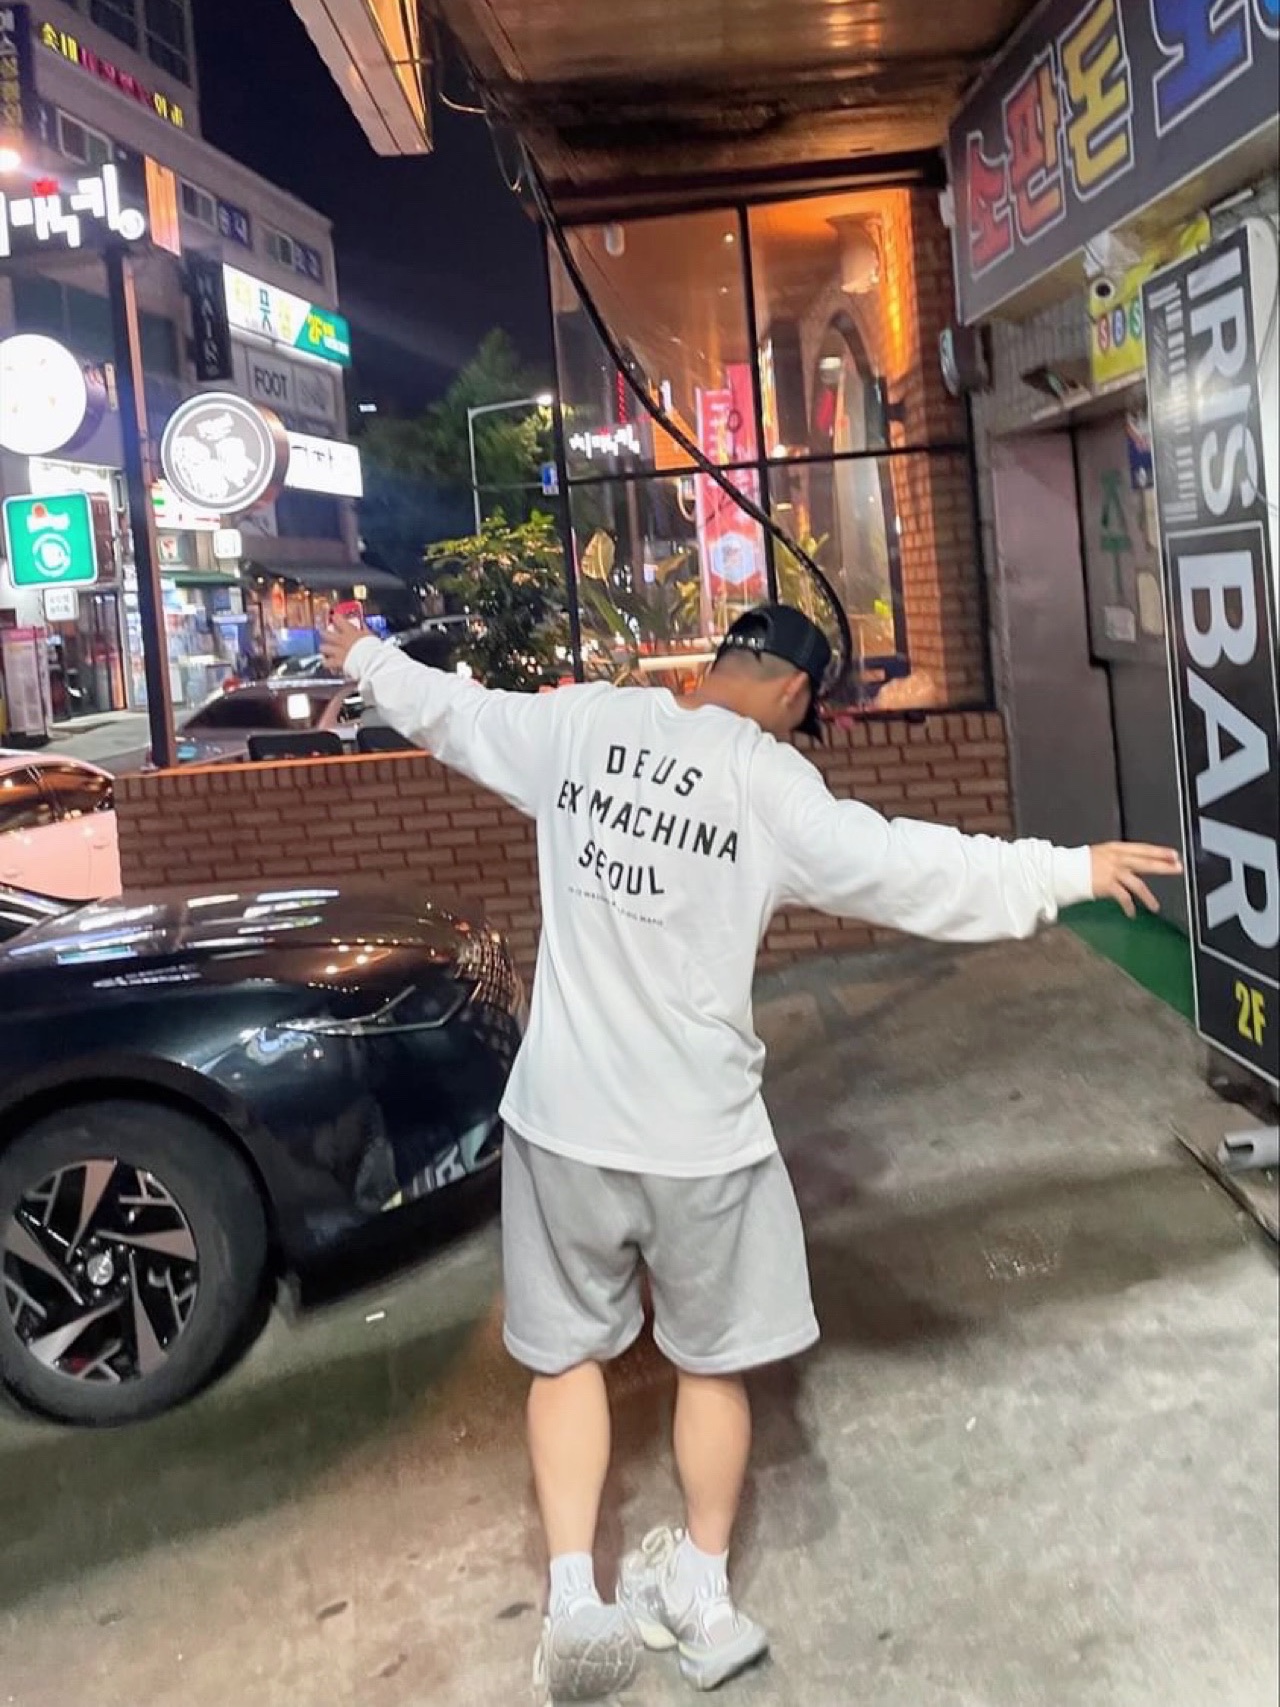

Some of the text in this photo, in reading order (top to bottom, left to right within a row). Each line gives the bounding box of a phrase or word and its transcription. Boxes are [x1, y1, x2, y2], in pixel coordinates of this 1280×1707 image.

[254, 366, 288, 400] FOOT
[1186, 247, 1259, 516] IRIS
[606, 744, 703, 796] DEUS
[1177, 551, 1280, 949] BAR
[557, 779, 739, 864] EX MACHINA
[578, 839, 665, 895] SEOUL
[1235, 979, 1267, 1047] 2F
